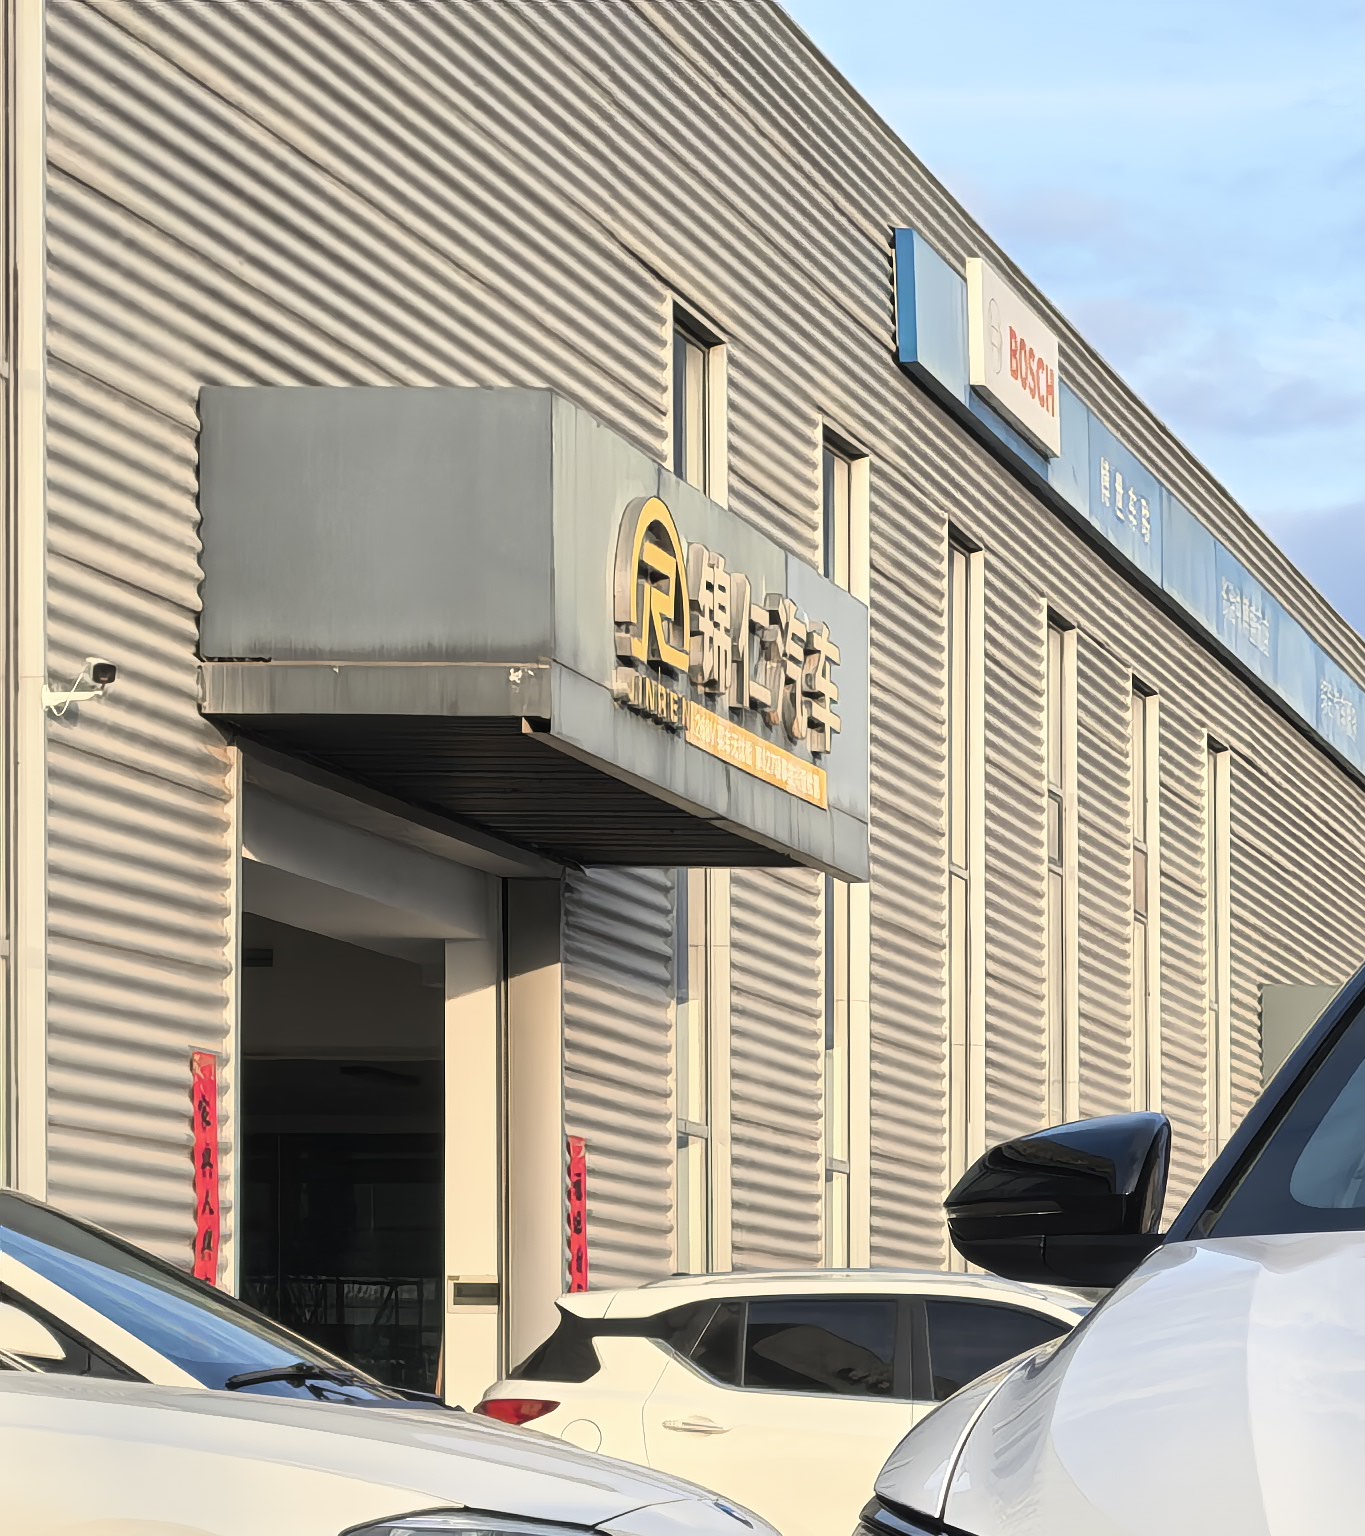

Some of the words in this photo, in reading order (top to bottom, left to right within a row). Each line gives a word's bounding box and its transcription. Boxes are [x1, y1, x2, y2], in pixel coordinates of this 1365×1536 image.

[1008, 325, 1055, 418] BOSCH
[688, 543, 842, 754] 锦仁汽车
